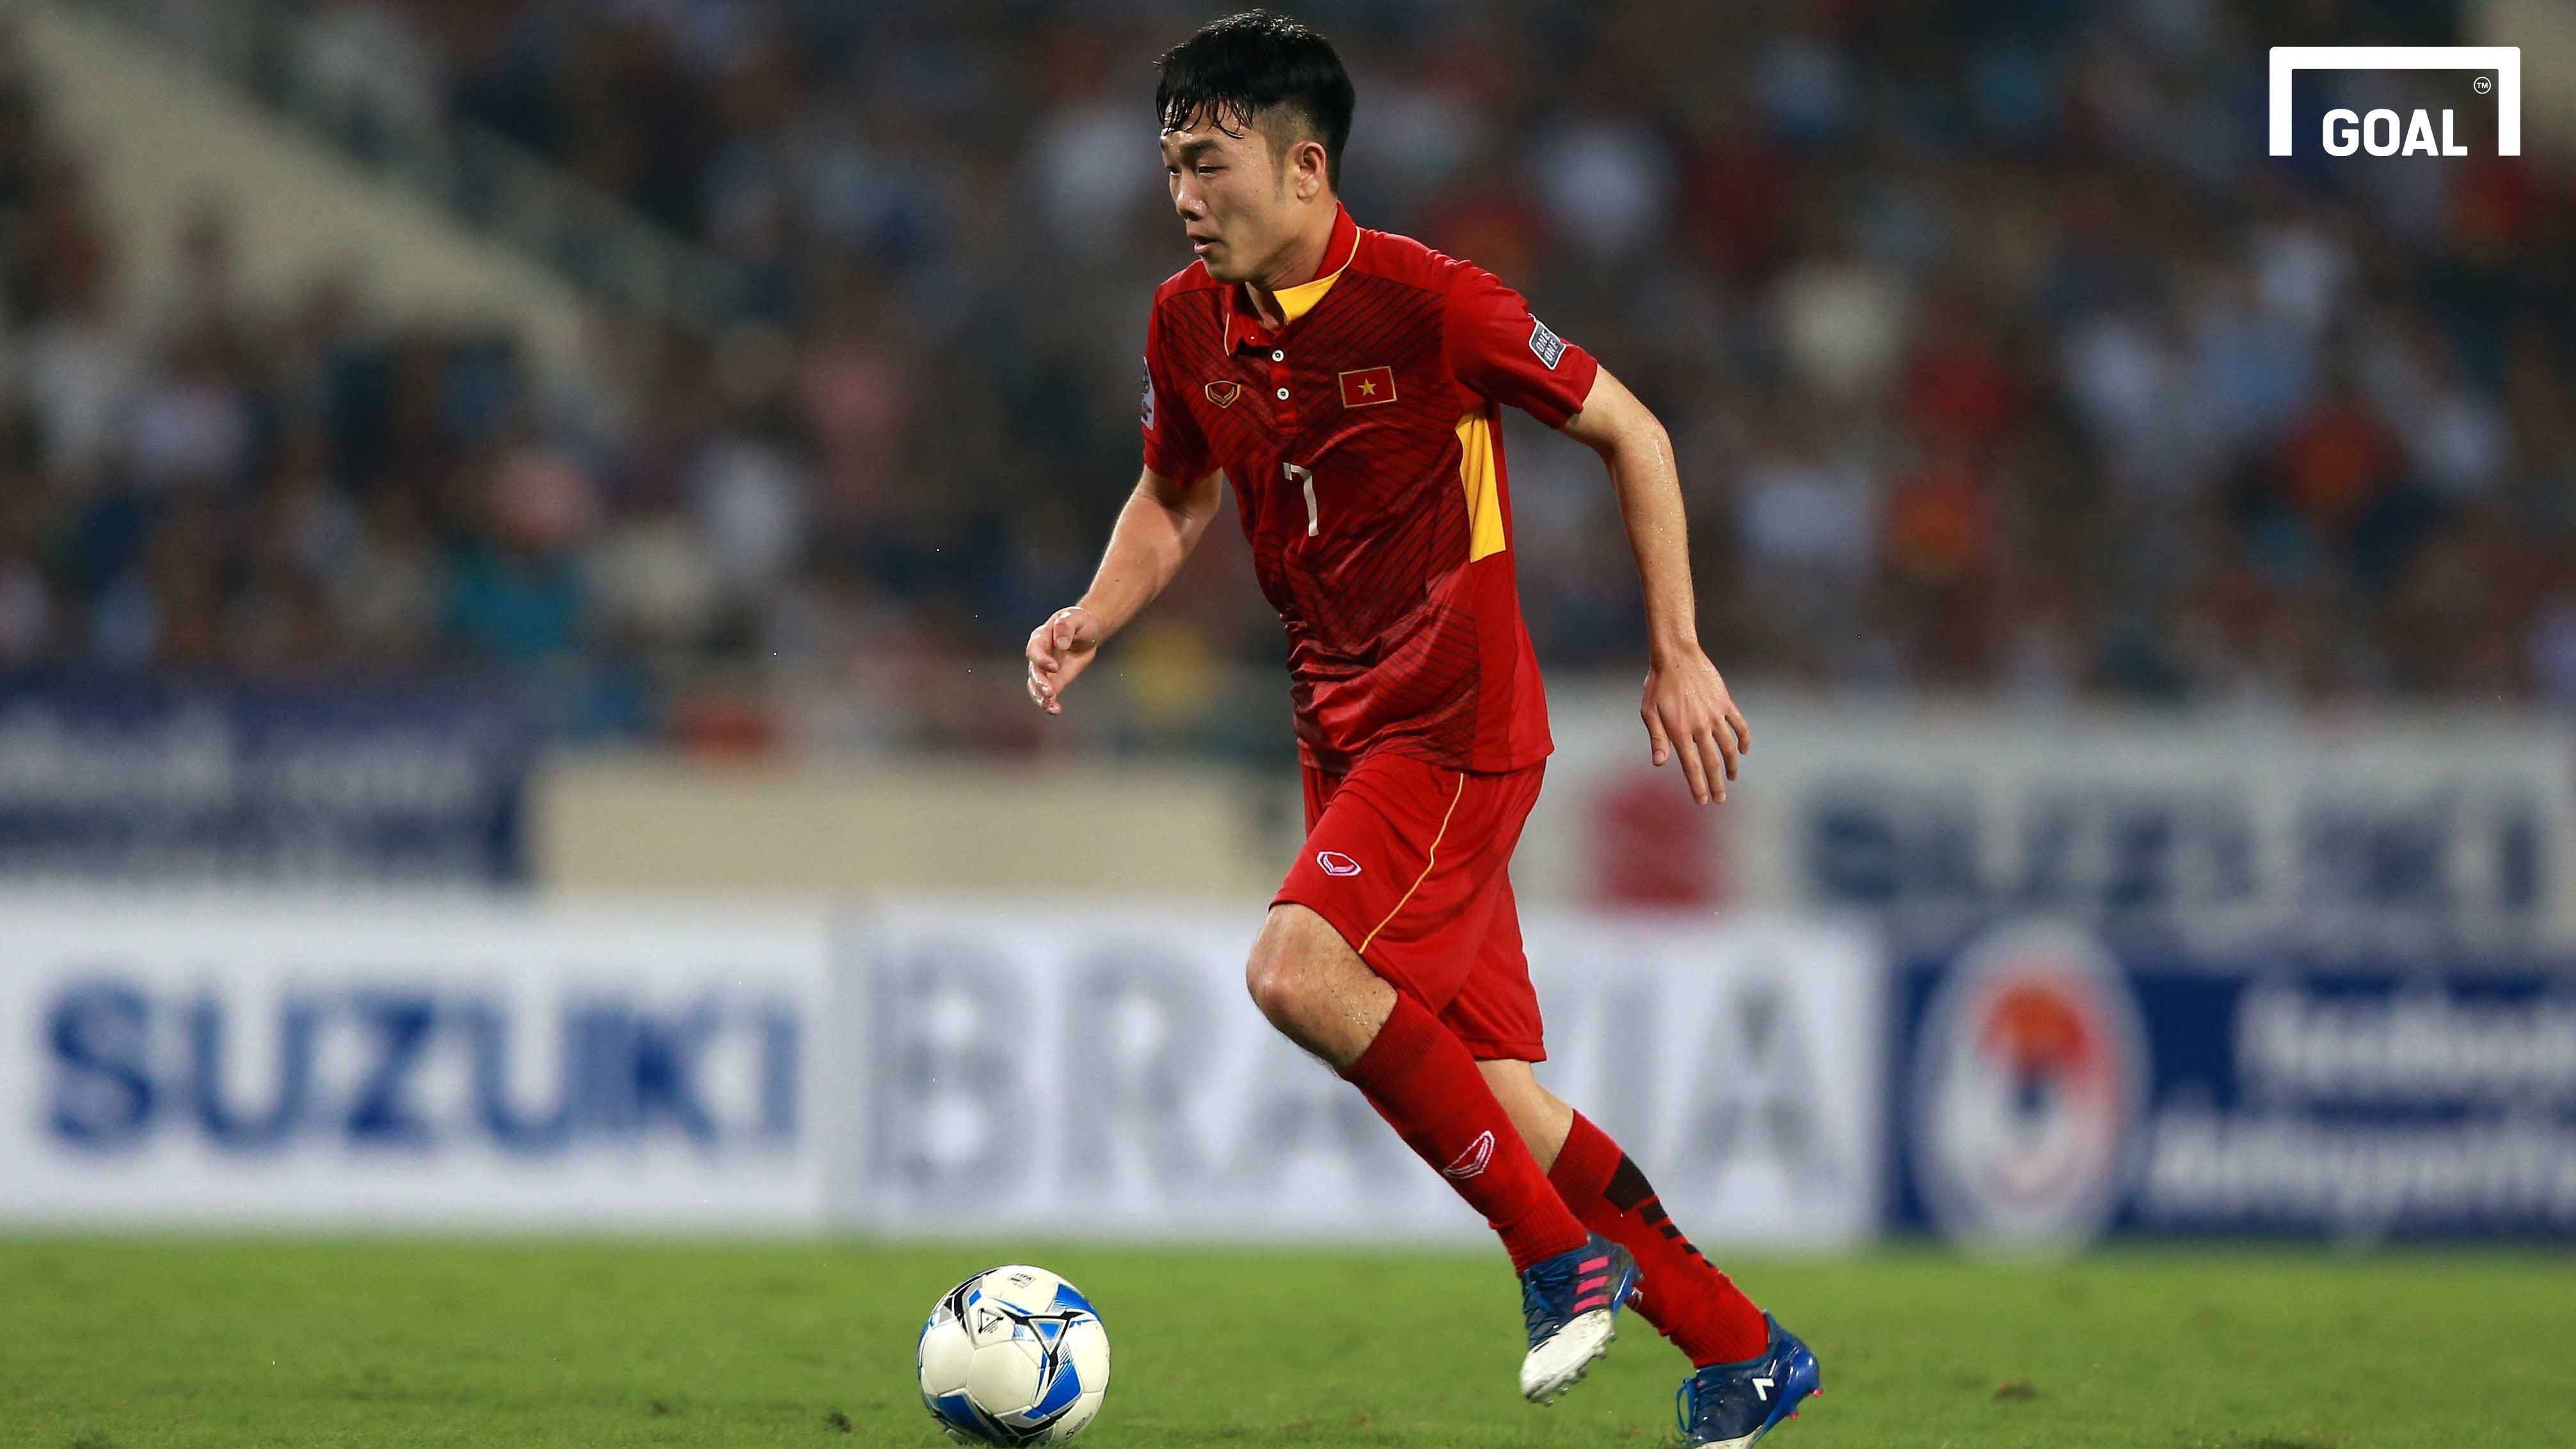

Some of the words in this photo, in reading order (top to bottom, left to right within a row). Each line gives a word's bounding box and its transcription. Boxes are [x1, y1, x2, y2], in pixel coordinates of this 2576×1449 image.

[1536, 329, 1551, 353] ONE
[1283, 462, 1319, 537] 7
[45, 978, 800, 1155] SUZUKI
